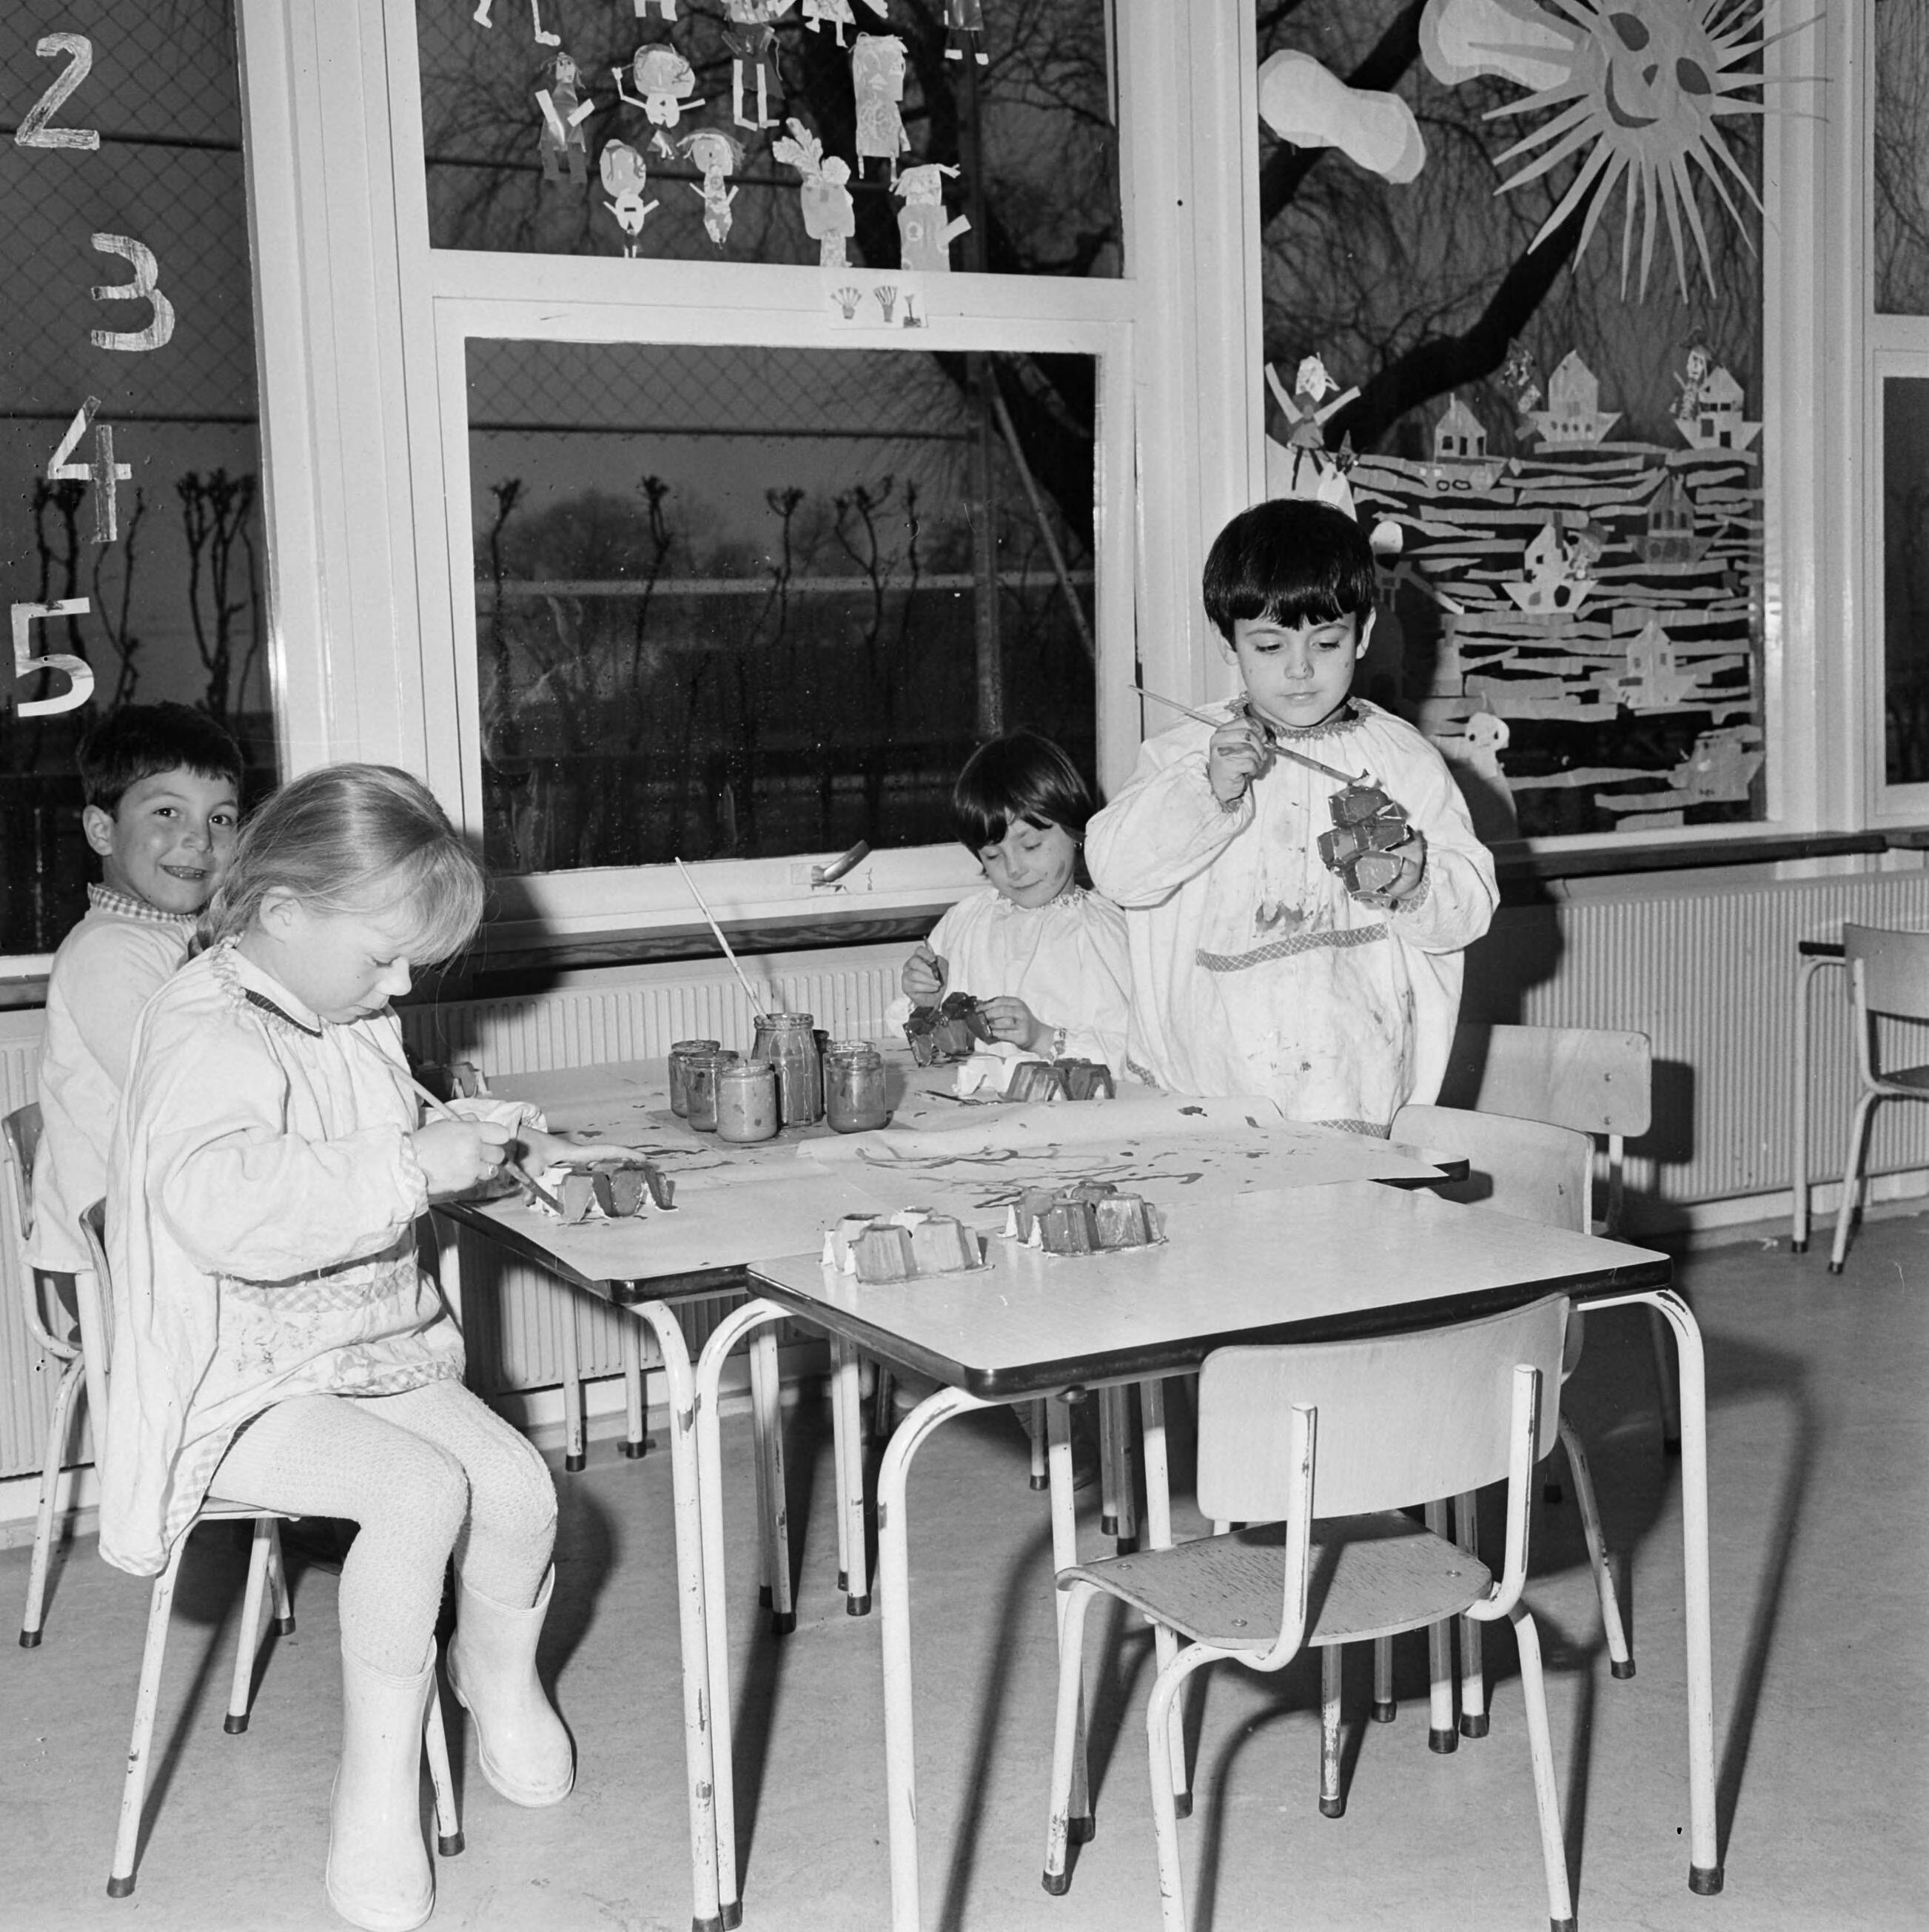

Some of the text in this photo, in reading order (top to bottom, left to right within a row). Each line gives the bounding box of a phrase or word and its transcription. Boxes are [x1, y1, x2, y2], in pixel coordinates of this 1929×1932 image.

[15, 33, 100, 150] 2
[91, 232, 175, 352] 3
[47, 396, 132, 543] 4
[10, 597, 94, 718] 5
